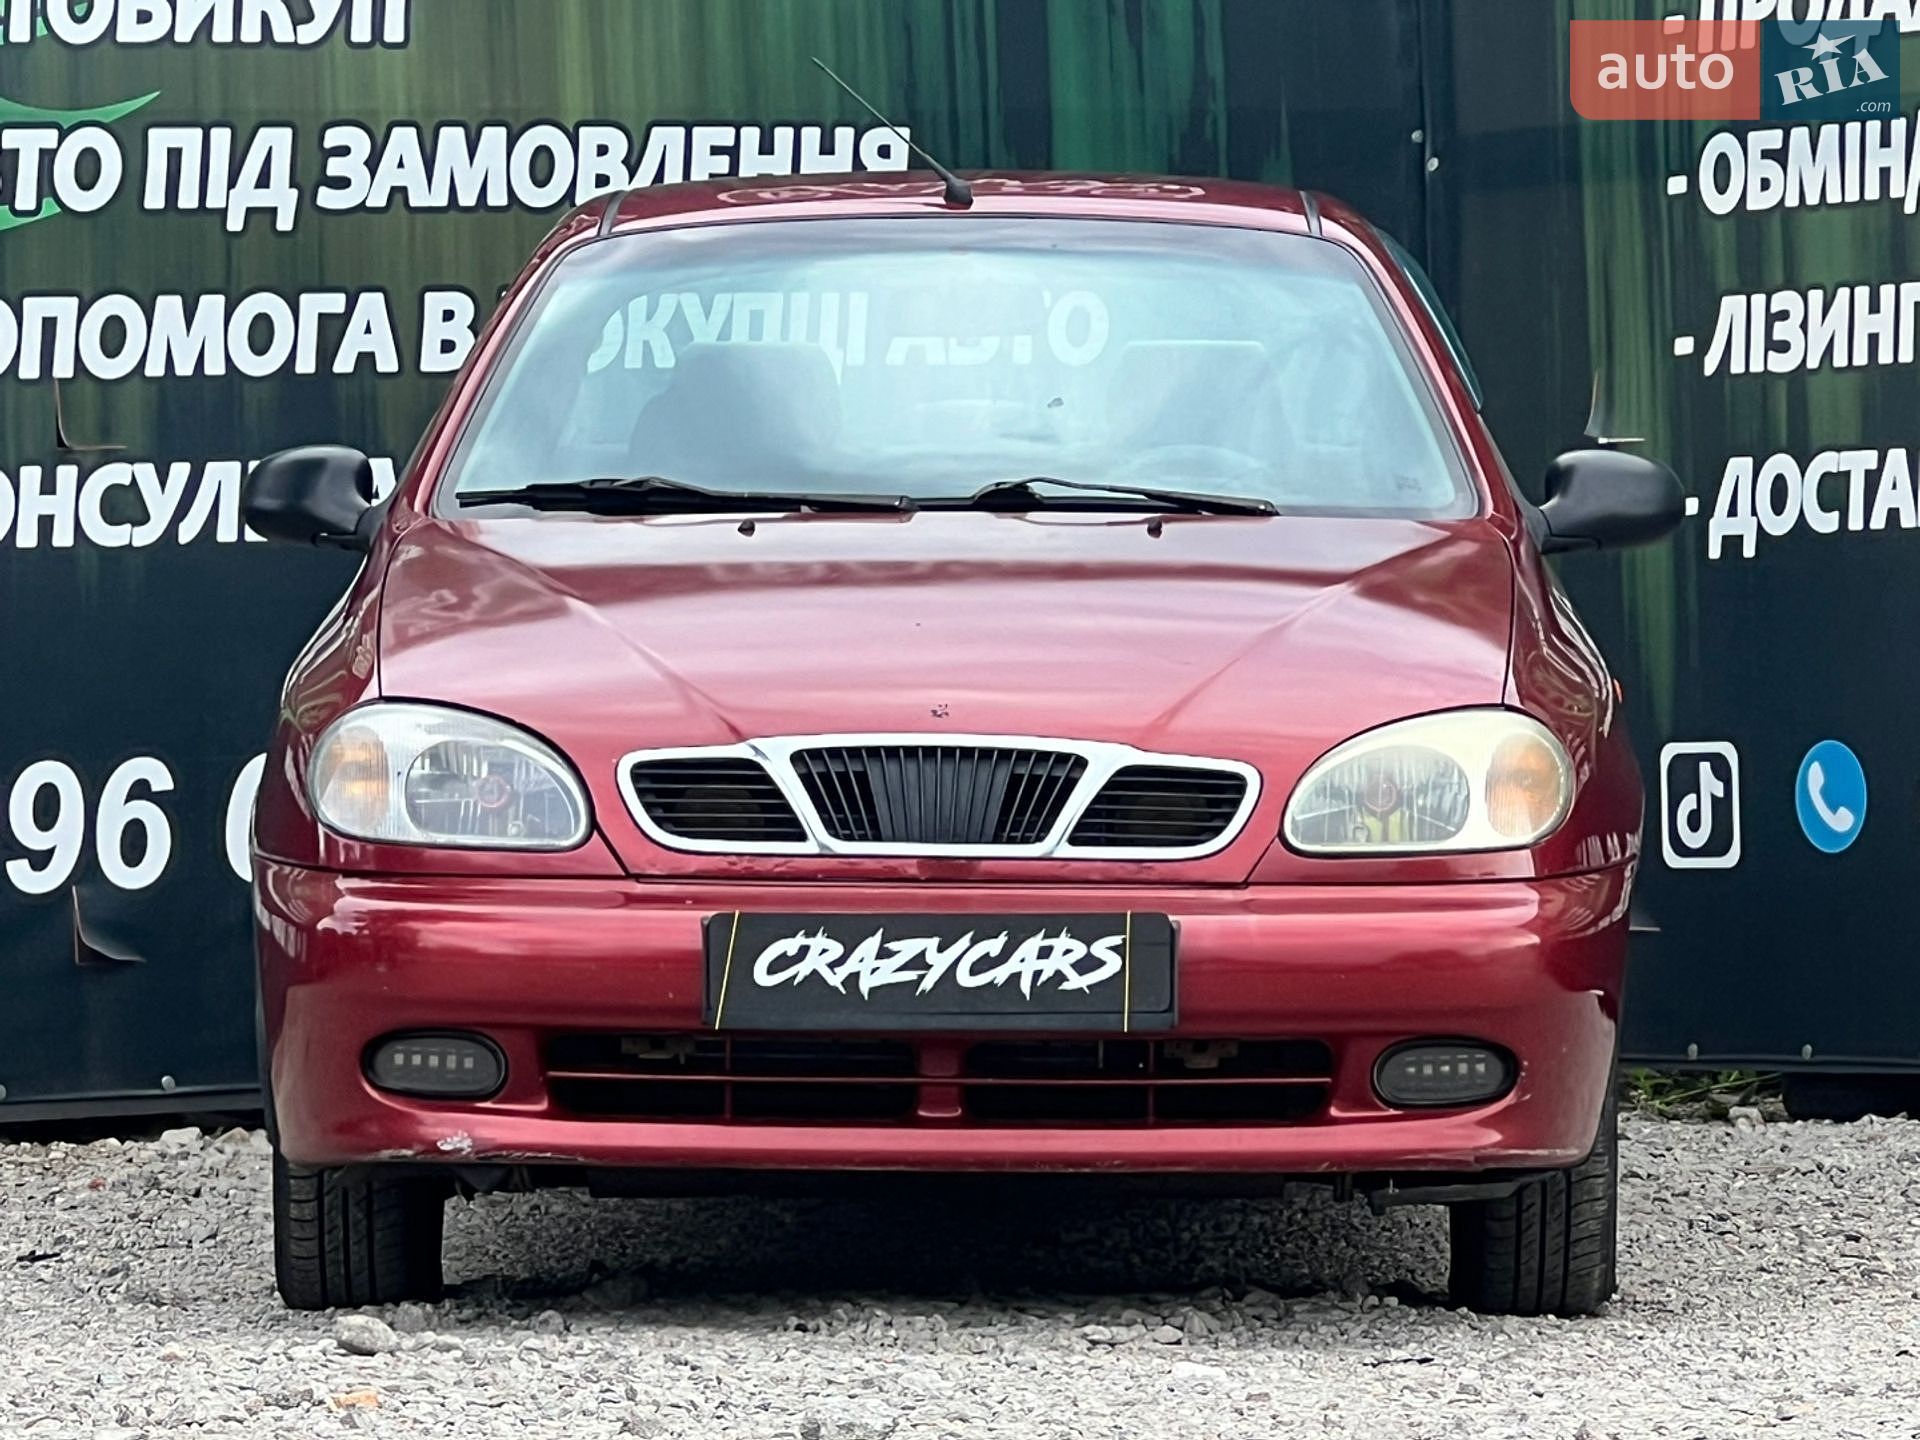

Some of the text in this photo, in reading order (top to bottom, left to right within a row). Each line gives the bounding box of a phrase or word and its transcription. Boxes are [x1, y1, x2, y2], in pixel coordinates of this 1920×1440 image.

[1, 123, 911, 232] ТО ПІД ЗАМОВЛЕННЯ
[0, 292, 400, 380] ПОМОГА
[420, 291, 476, 373] В
[1708, 448, 1920, 560] ДОСТА
[5, 756, 175, 894] 96
[753, 926, 1128, 1001] CRAZYCARS
